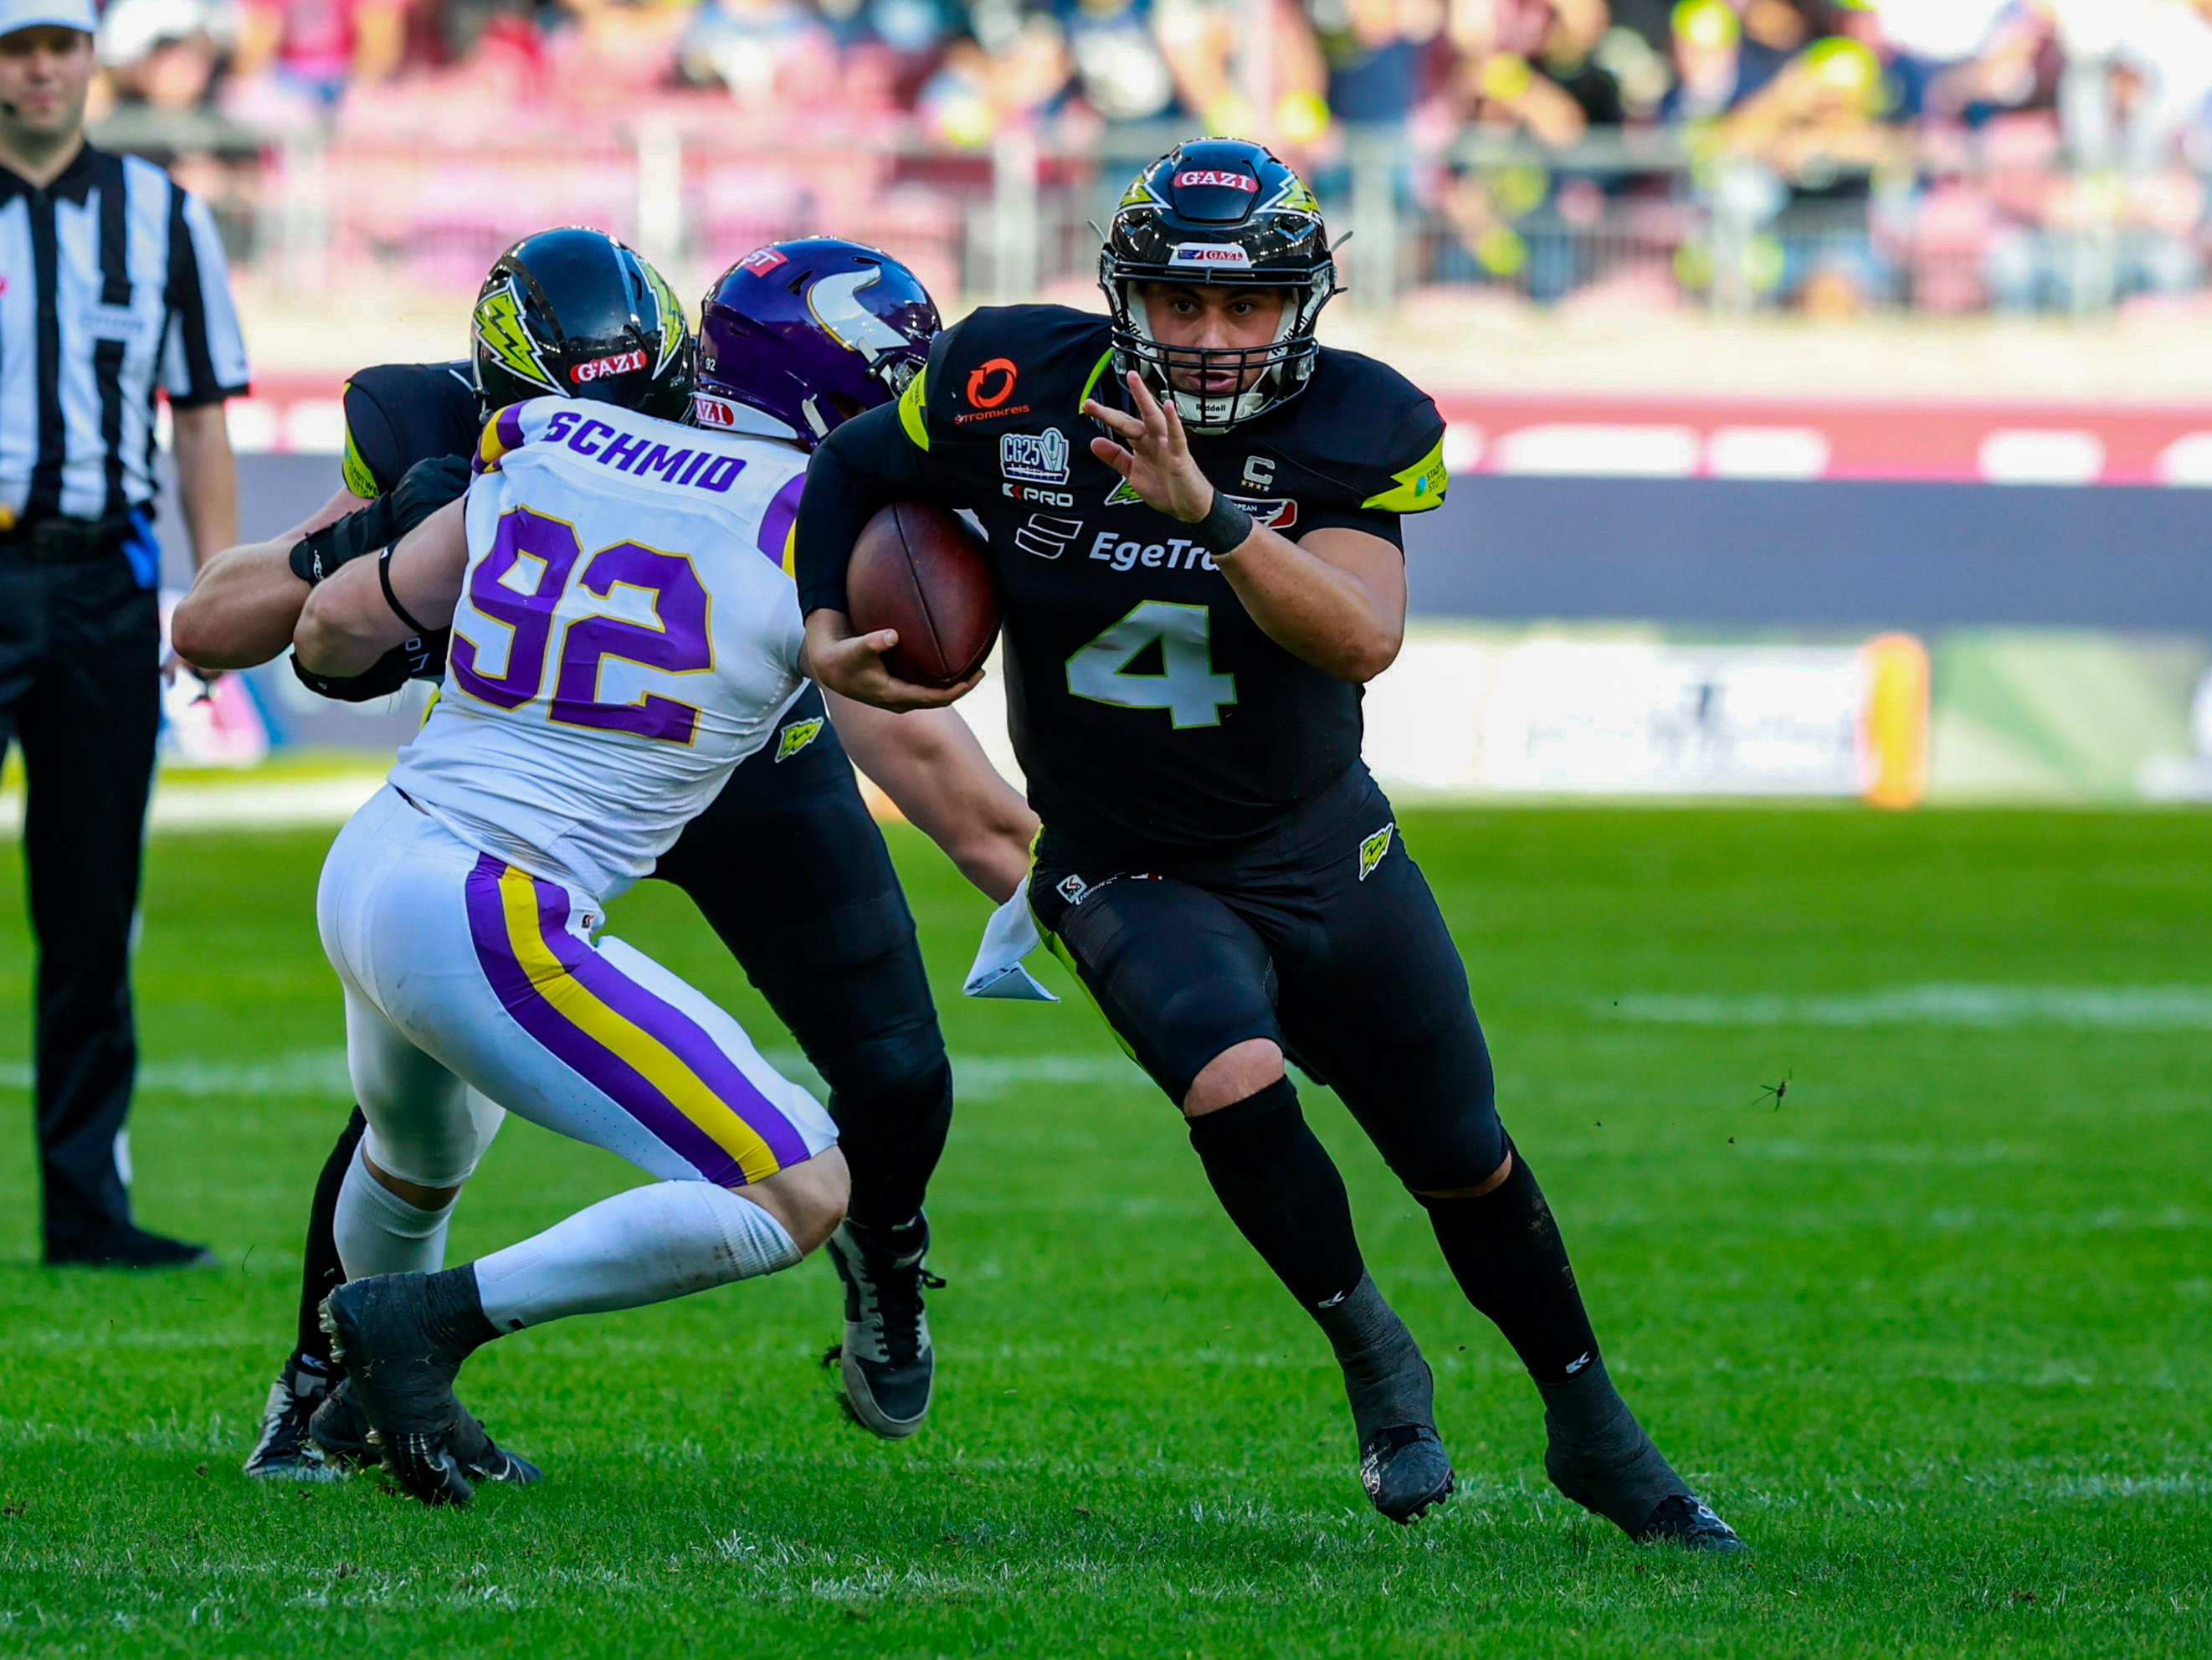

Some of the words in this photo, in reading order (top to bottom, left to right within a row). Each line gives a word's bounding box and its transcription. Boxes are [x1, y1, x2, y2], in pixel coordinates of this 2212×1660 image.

[1181, 171, 1250, 191] GAZI
[577, 351, 644, 383] GAZI
[704, 357, 716, 372] 92
[695, 397, 727, 424] AZI
[1195, 403, 1227, 413] Rddell
[539, 410, 747, 493] SCHMID
[1089, 532, 1221, 572] EgeTra
[445, 502, 716, 748] 92
[1065, 599, 1239, 730] 4
